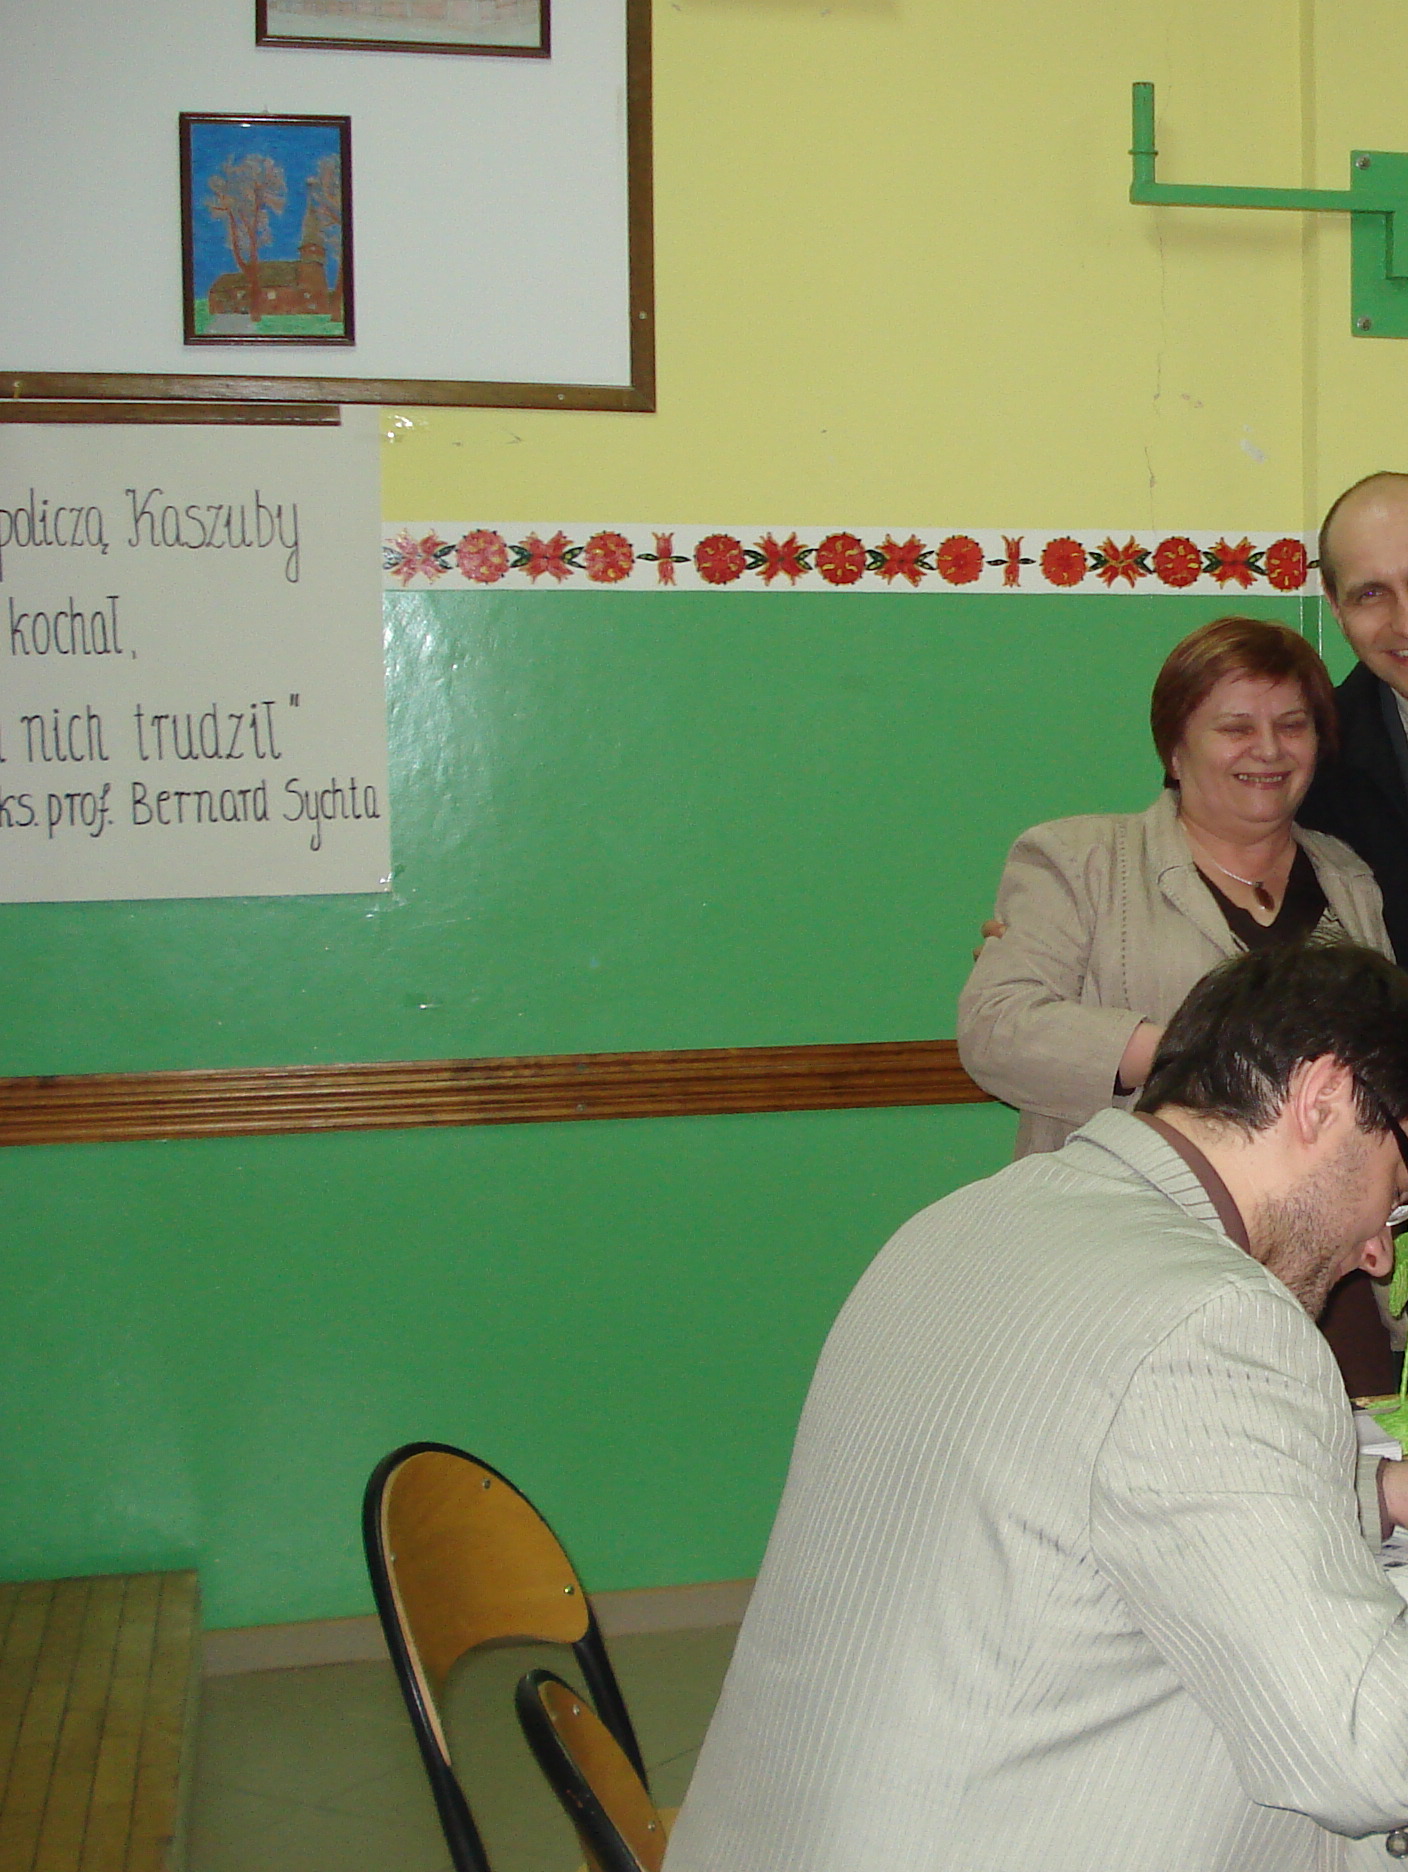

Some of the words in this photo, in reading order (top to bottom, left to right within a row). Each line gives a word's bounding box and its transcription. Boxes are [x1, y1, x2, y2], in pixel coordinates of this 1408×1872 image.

[125, 488, 301, 583] Kaszuby
[8, 595, 137, 659] kochał,
[20, 704, 110, 763] nich
[131, 779, 271, 826] Bernard
[283, 776, 382, 852] Sychta
